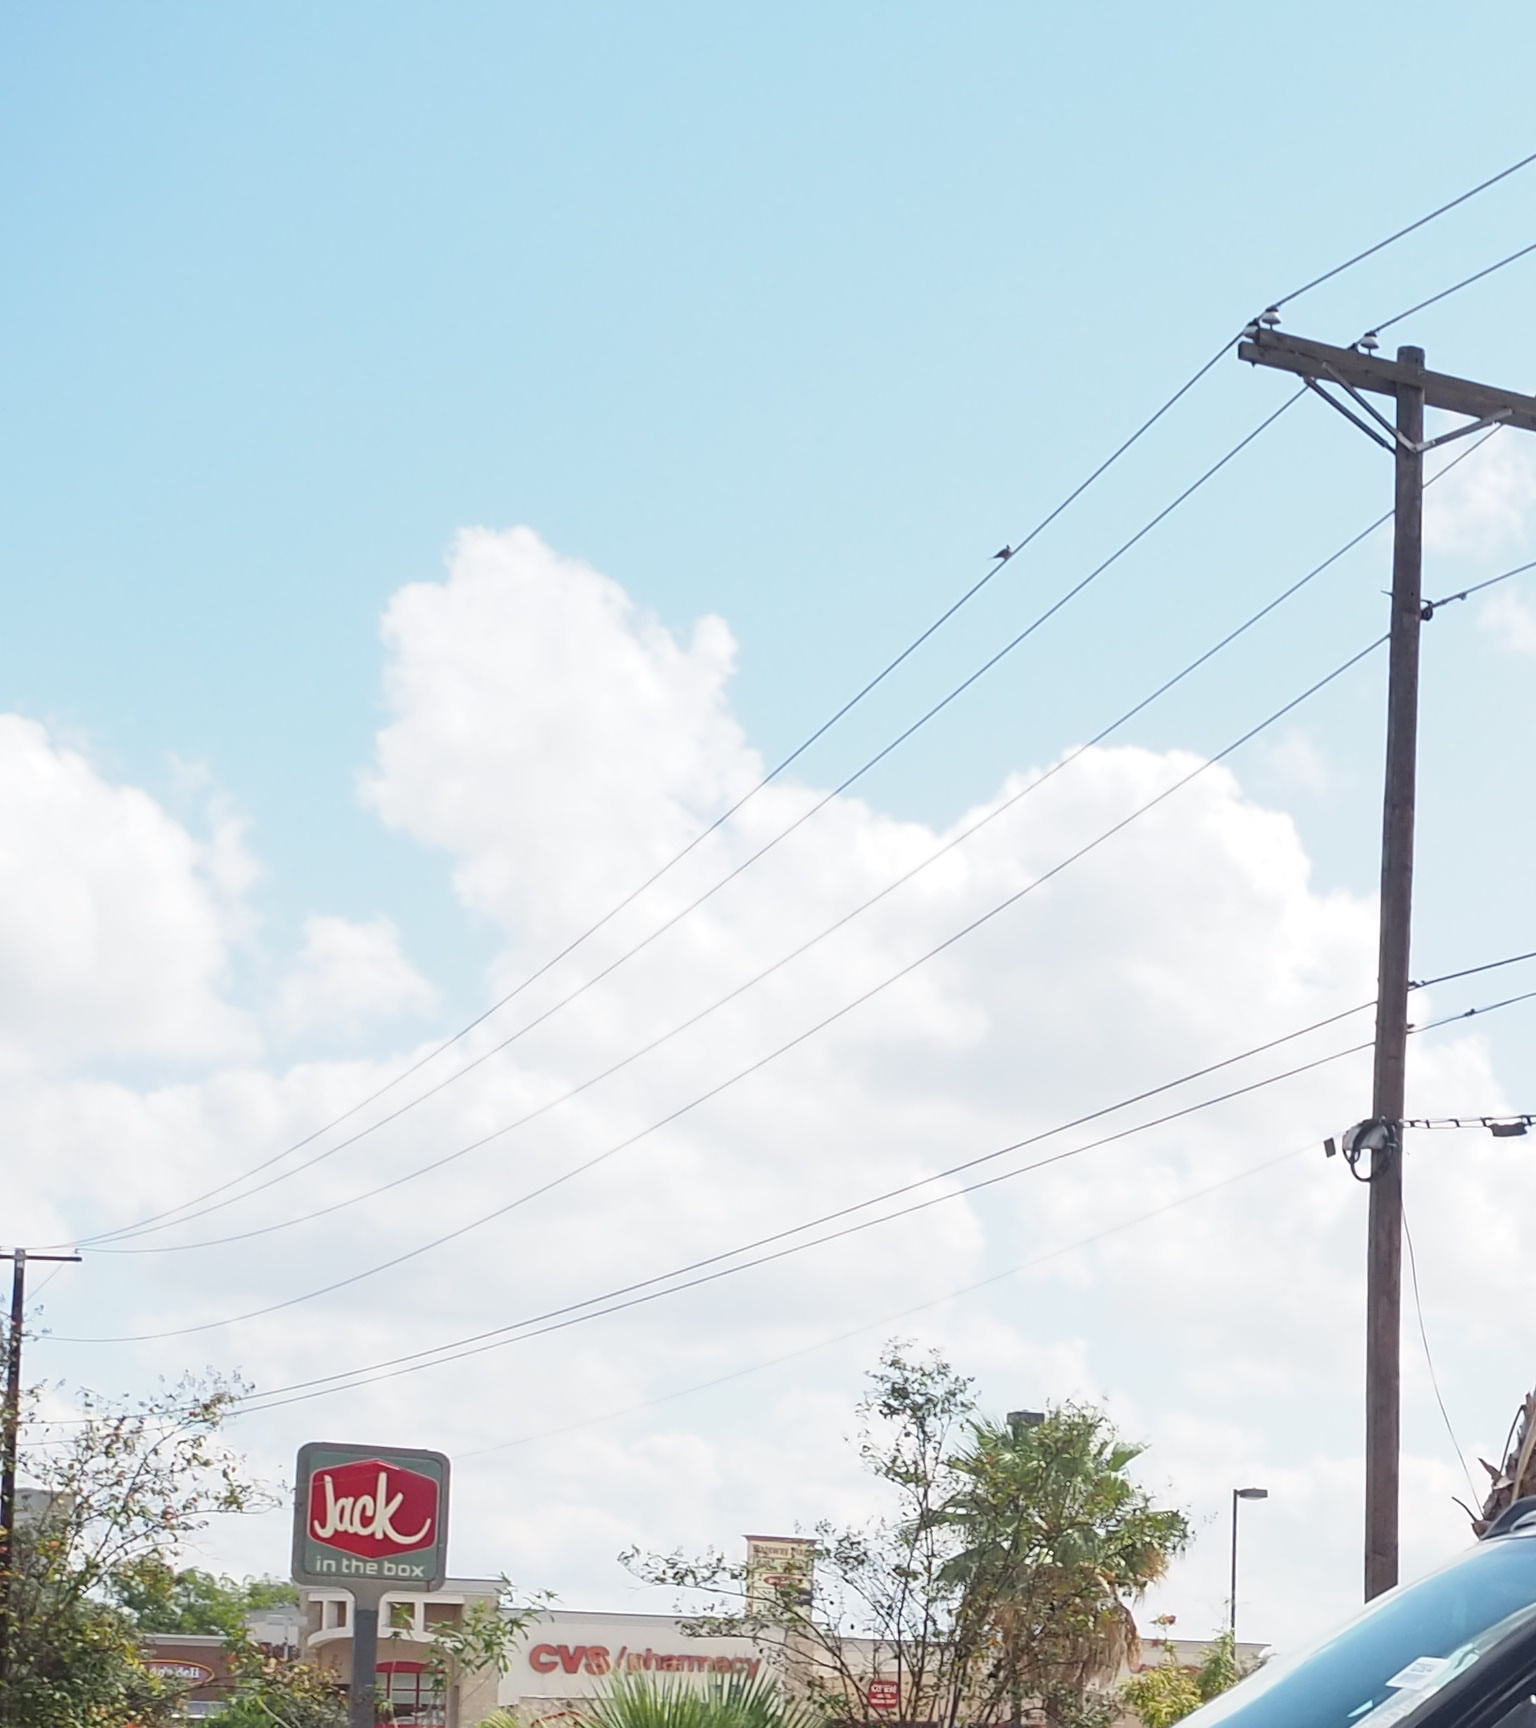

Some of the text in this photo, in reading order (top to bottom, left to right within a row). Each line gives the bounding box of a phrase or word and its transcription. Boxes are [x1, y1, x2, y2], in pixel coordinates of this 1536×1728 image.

[313, 1471, 432, 1545] Jack
[316, 1556, 425, 1577] in the box
